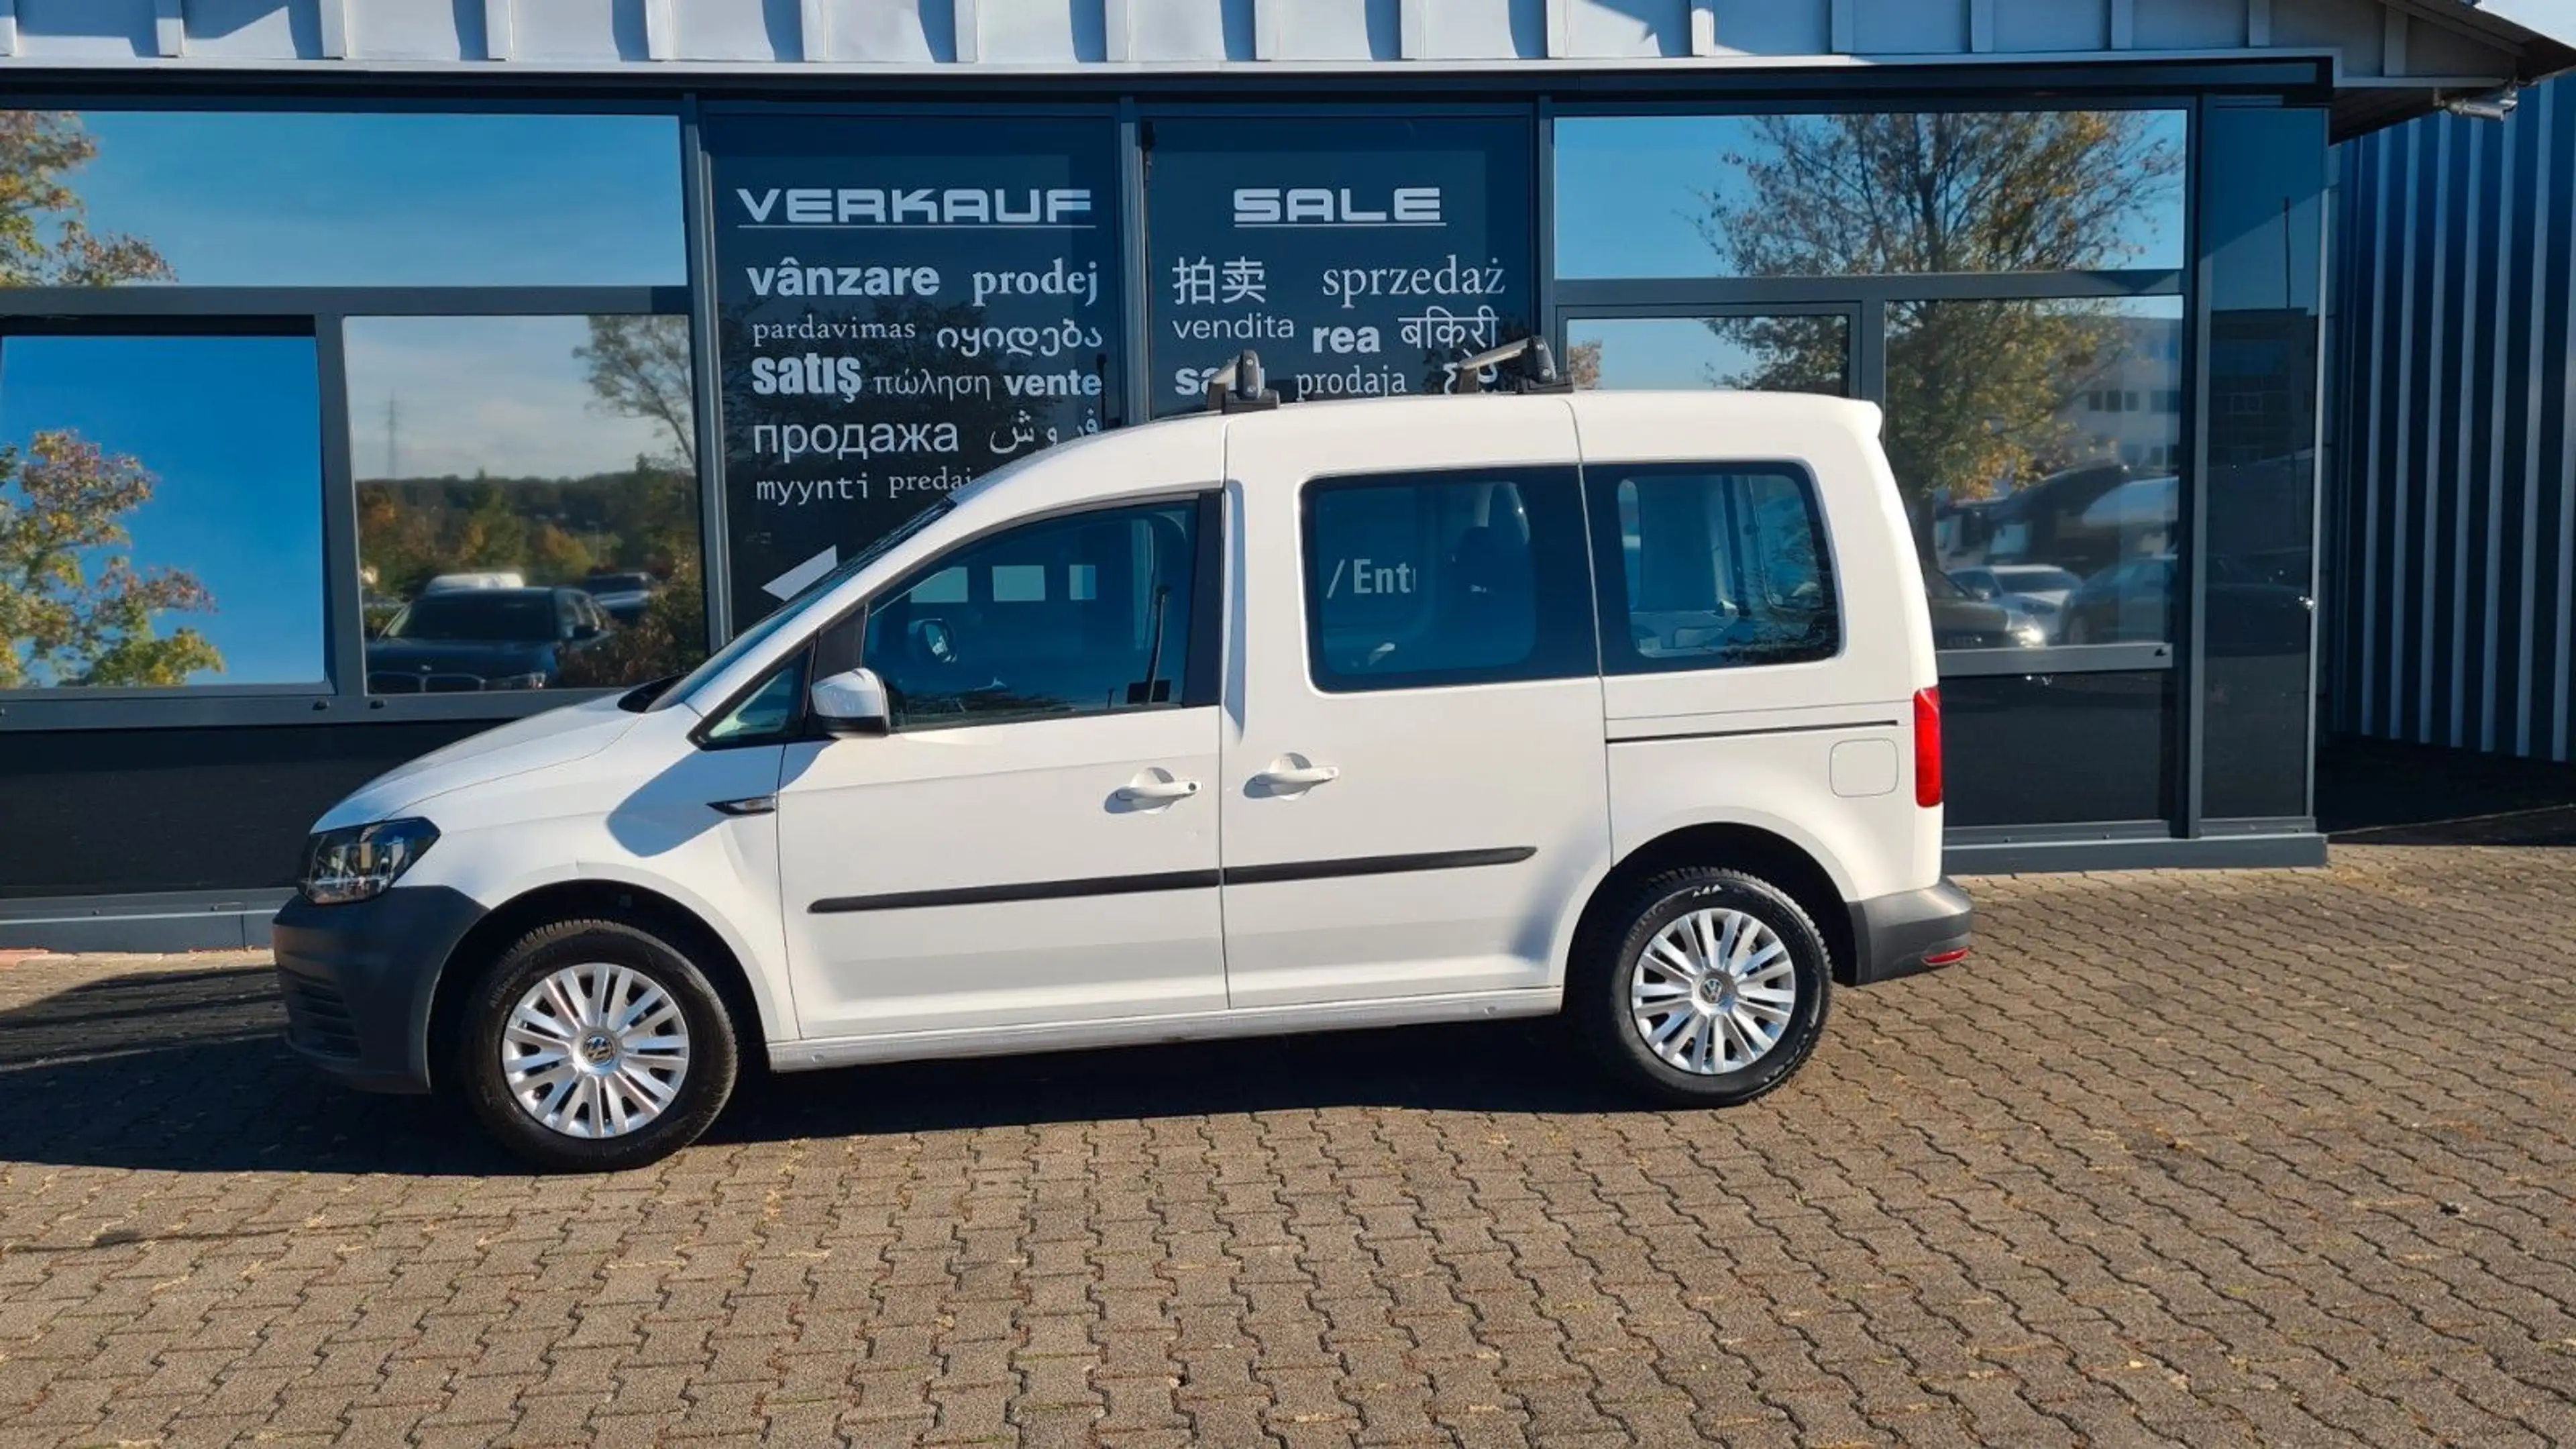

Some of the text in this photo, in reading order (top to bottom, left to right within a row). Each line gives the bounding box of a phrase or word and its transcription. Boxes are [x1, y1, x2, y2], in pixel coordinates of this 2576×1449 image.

[737, 189, 1091, 223] VERKAUF
[1234, 187, 1440, 222] SALE
[746, 257, 1097, 307] vânzare prodej
[1172, 256, 1267, 305] 拍卖
[1322, 254, 1505, 309] sprzedaż
[752, 313, 916, 347] pardavimas
[936, 318, 1103, 358] იყიდება
[1172, 312, 1381, 354] vendita rea
[751, 352, 861, 402] satış
[873, 368, 991, 401] πώληση
[1003, 369, 1102, 396] vente
[1295, 364, 1407, 402] prodaja
[753, 423, 959, 464] продажа
[756, 472, 867, 506] myynti
[1354, 558, 1416, 594] Ent
